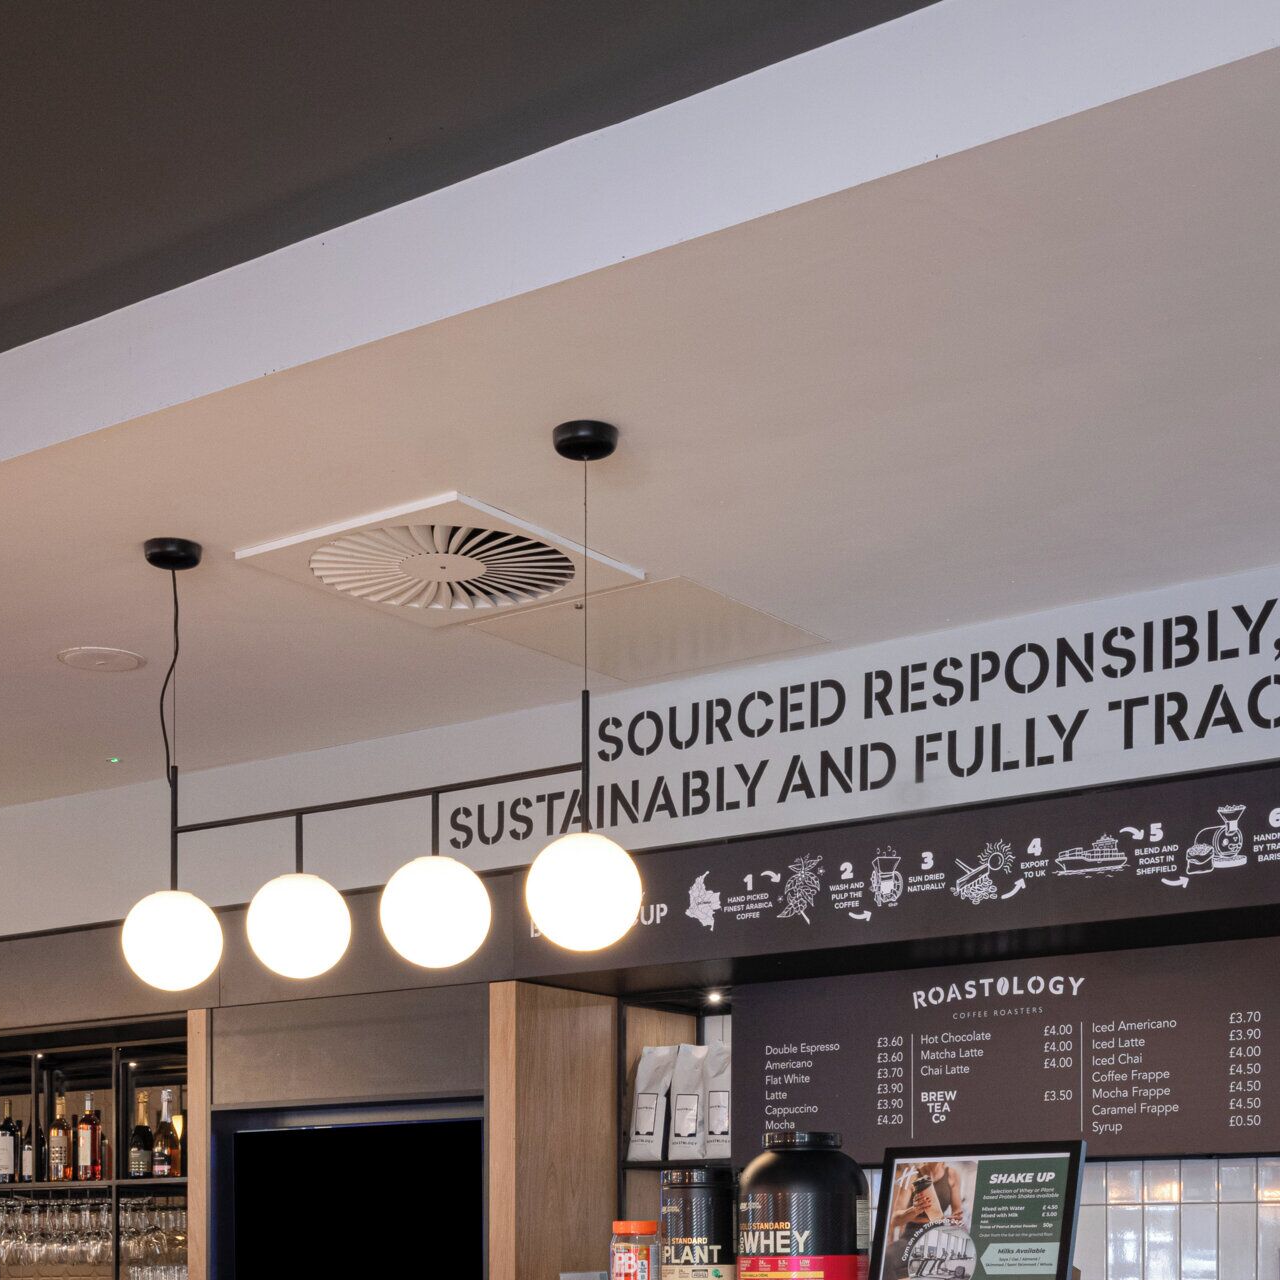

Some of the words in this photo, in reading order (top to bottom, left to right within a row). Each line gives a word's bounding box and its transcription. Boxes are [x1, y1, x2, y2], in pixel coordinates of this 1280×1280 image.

[597, 678, 846, 761] SOURCED
[449, 759, 770, 850] SUSTAINABLY
[776, 742, 897, 803] AND
[914, 708, 1090, 784] FULLY
[1149, 823, 1163, 842] 5
[1027, 838, 1042, 855] 4
[1135, 846, 1160, 856] BLEND
[1162, 844, 1179, 853] AND
[1253, 842, 1264, 852] BY
[921, 852, 934, 869] 3
[1020, 859, 1049, 869] EXPORT
[1139, 855, 1163, 865] ROAST
[1166, 855, 1174, 863] IN
[840, 862, 853, 879] 2
[908, 875, 922, 883] SUN
[924, 873, 945, 881] DRIED
[1035, 869, 1046, 877] UK
[1136, 864, 1177, 876] SHEFFIELD
[743, 874, 753, 890] 1
[829, 883, 849, 891] WASH
[850, 881, 864, 889] AND
[908, 882, 946, 892] NATURALLY
[728, 894, 745, 903] HAND
[746, 893, 769, 902] PICKED
[831, 892, 848, 900] PULP
[834, 900, 859, 909] COFFEE
[723, 904, 744, 913] FINEST
[746, 902, 773, 911] ARABICA
[736, 912, 760, 920] COFFEE
[912, 975, 1085, 1009] ROASTOLOGY
[952, 1010, 988, 1020] COFFEE
[993, 1006, 1043, 1017] ROASTERS
[1092, 1022, 1114, 1033] Iced
[1118, 1019, 1177, 1031] Americano
[1229, 1012, 1261, 1024] £3.70
[920, 1034, 939, 1045] Hot
[941, 1031, 991, 1043] Chocolate
[1044, 1025, 1073, 1036] £4.00
[1092, 1040, 1114, 1050] Iced
[1118, 1038, 1145, 1048] Latte
[1229, 1029, 1261, 1041] £3.90
[765, 1044, 798, 1055] Double
[800, 1042, 840, 1054] Espresso
[877, 1037, 903, 1047] £3.60
[920, 1049, 956, 1060] Matcha
[959, 1047, 984, 1058] Latte
[1044, 1041, 1073, 1052] £4.00
[765, 1059, 812, 1070] Americano
[877, 1052, 903, 1063] £3.60
[1092, 1056, 1114, 1066] Iced
[1118, 1054, 1143, 1064] Chai
[1229, 1046, 1261, 1058] £4.00
[920, 1065, 943, 1076] Chai
[945, 1064, 970, 1075] Latte
[1044, 1057, 1073, 1069] £4.00
[1092, 1071, 1127, 1083] Coffee
[1131, 1070, 1170, 1083] Frappe
[1229, 1063, 1261, 1075] £4.50
[765, 1075, 782, 1085] Flat
[784, 1074, 810, 1084] White
[877, 1067, 903, 1079] £3.70
[765, 1090, 787, 1100] Latte
[877, 1083, 903, 1094] £3.90
[920, 1090, 957, 1102] BREW
[1044, 1090, 1073, 1102] £3.50
[1092, 1088, 1128, 1098] Mocha
[1132, 1086, 1170, 1100] Frappe
[1229, 1081, 1261, 1092] £4.50
[765, 1104, 818, 1118] Cappuccino
[877, 1099, 903, 1110] £3.90
[927, 1102, 950, 1113] TEA
[1092, 1104, 1137, 1115] Caramel
[1140, 1103, 1179, 1117] Frappe
[1229, 1098, 1261, 1110] £4.50
[765, 1120, 795, 1130] Mocha
[877, 1114, 903, 1125] £4.20
[932, 1114, 946, 1124] Co
[1092, 1122, 1122, 1135] Syrup
[1229, 1115, 1261, 1127] £0.50
[989, 1172, 1034, 1184] SHAKE
[1036, 1172, 1055, 1182] UP
[752, 1222, 790, 1230] STANDARD
[744, 1230, 810, 1253] WHEY
[664, 1246, 721, 1264] PLANT
